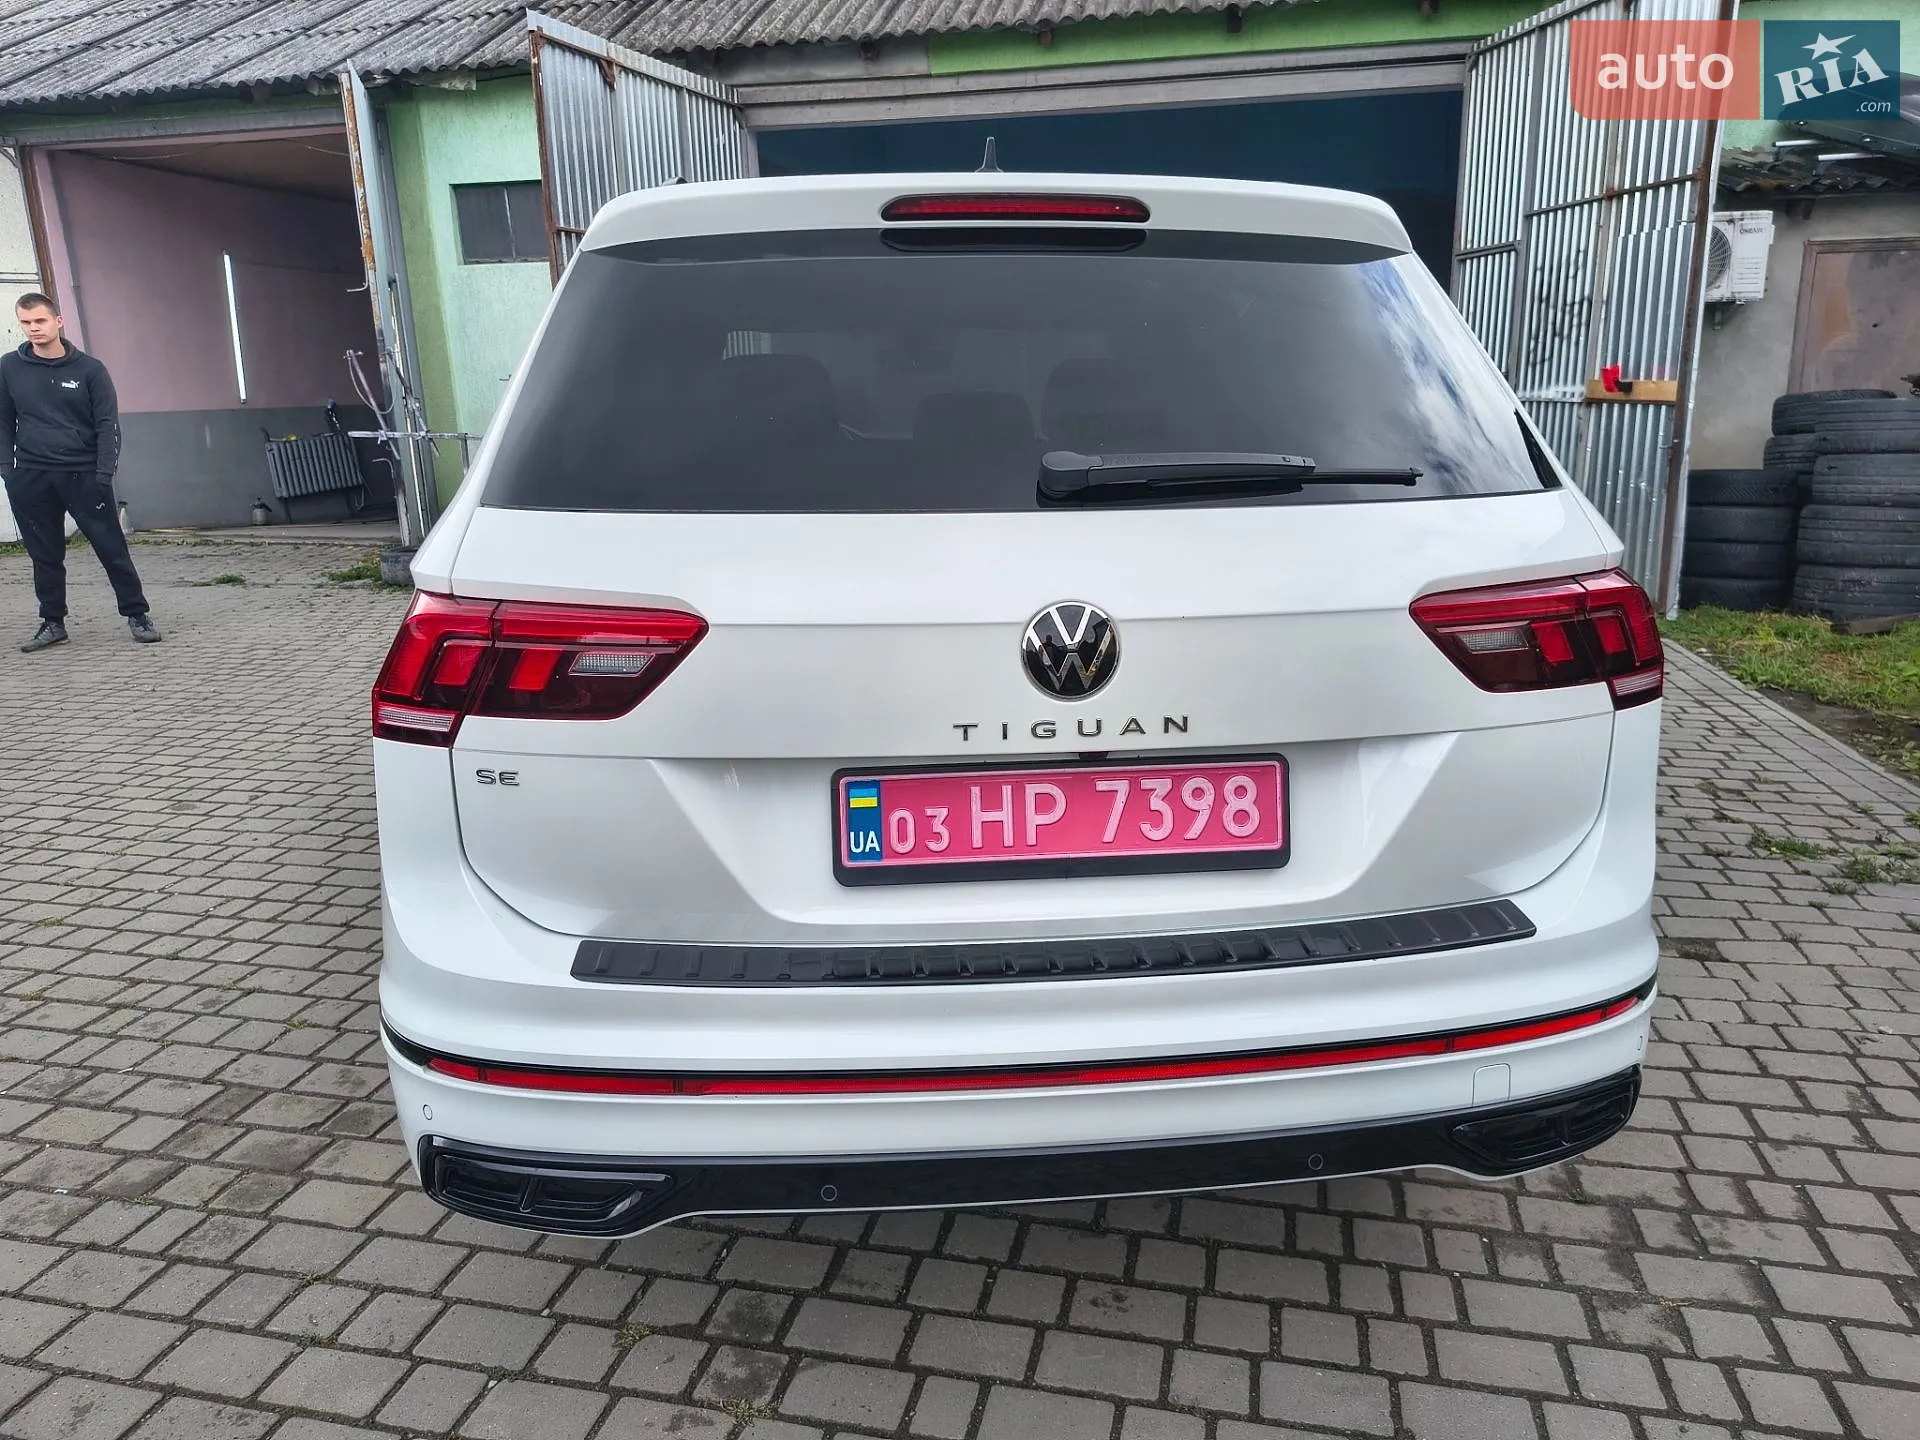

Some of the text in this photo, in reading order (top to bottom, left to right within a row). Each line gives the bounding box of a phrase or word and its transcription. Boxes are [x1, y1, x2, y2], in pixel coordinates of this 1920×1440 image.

[953, 714, 1188, 741] TIGUAN
[476, 769, 520, 786] SE
[850, 775, 1261, 854] UA 03 HP 7398
